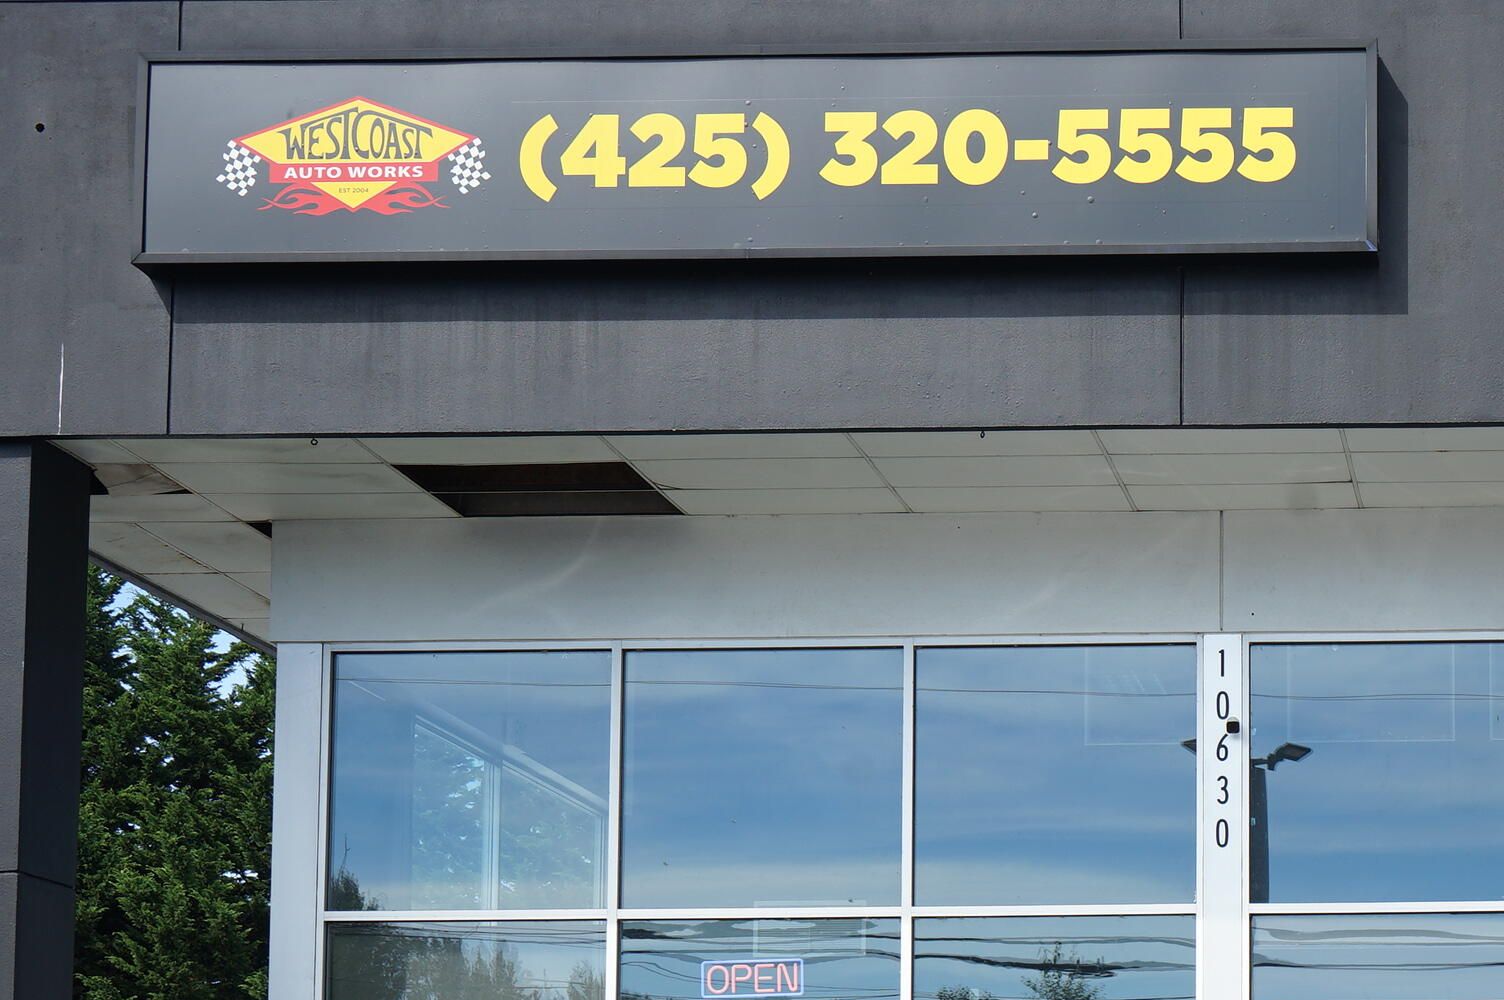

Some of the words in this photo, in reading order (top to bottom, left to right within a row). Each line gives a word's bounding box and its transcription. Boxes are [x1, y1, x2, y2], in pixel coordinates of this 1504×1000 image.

[284, 166, 342, 179] AUTO
[347, 165, 423, 178] WORKS
[520, 111, 790, 202] (425)
[818, 107, 1297, 187] 320-5555
[1215, 649, 1230, 848] 10630
[706, 963, 798, 994] OPEN
